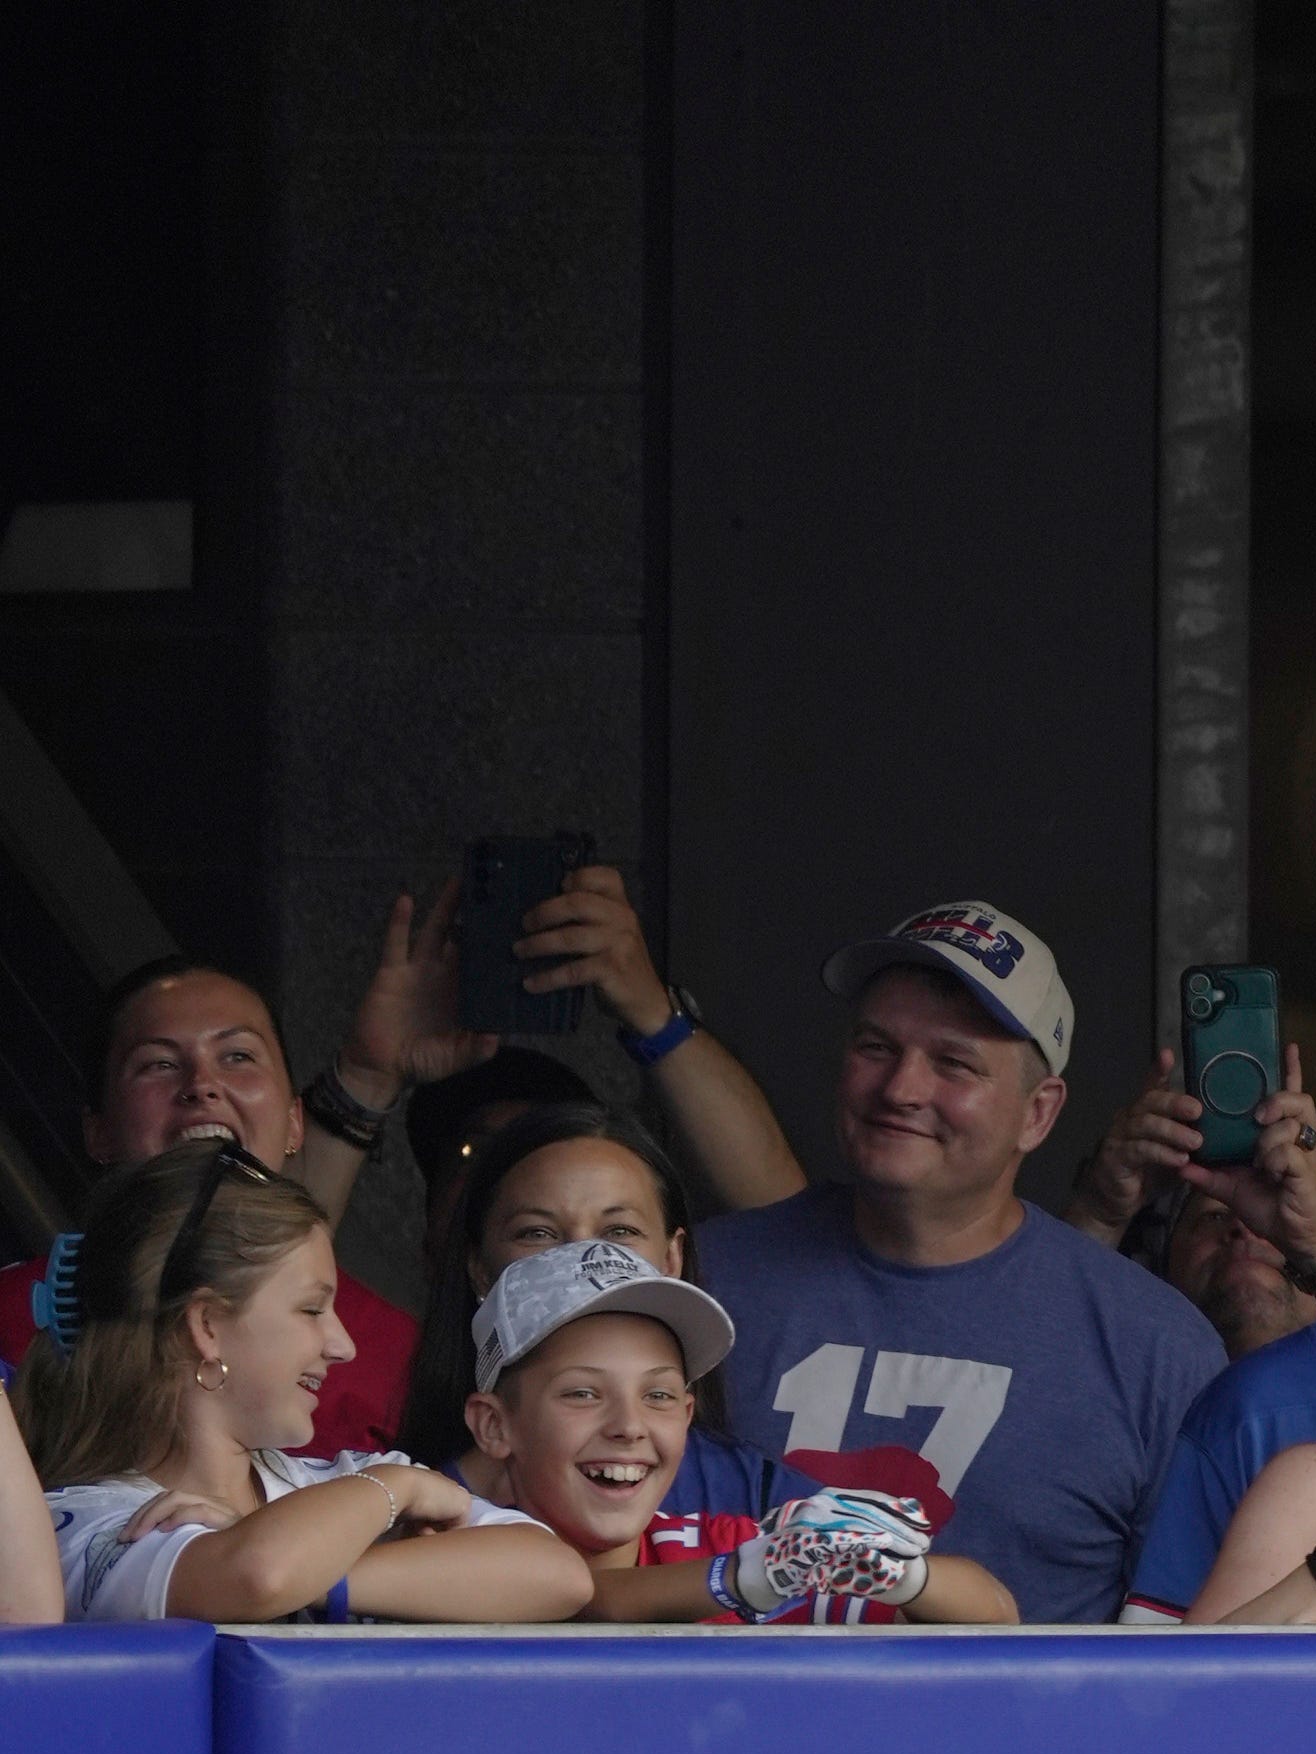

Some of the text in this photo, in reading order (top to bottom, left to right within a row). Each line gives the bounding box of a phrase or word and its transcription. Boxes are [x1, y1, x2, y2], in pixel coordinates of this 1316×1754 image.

[580, 1260, 638, 1272] JIM KELLY
[773, 1342, 1013, 1500] 17
